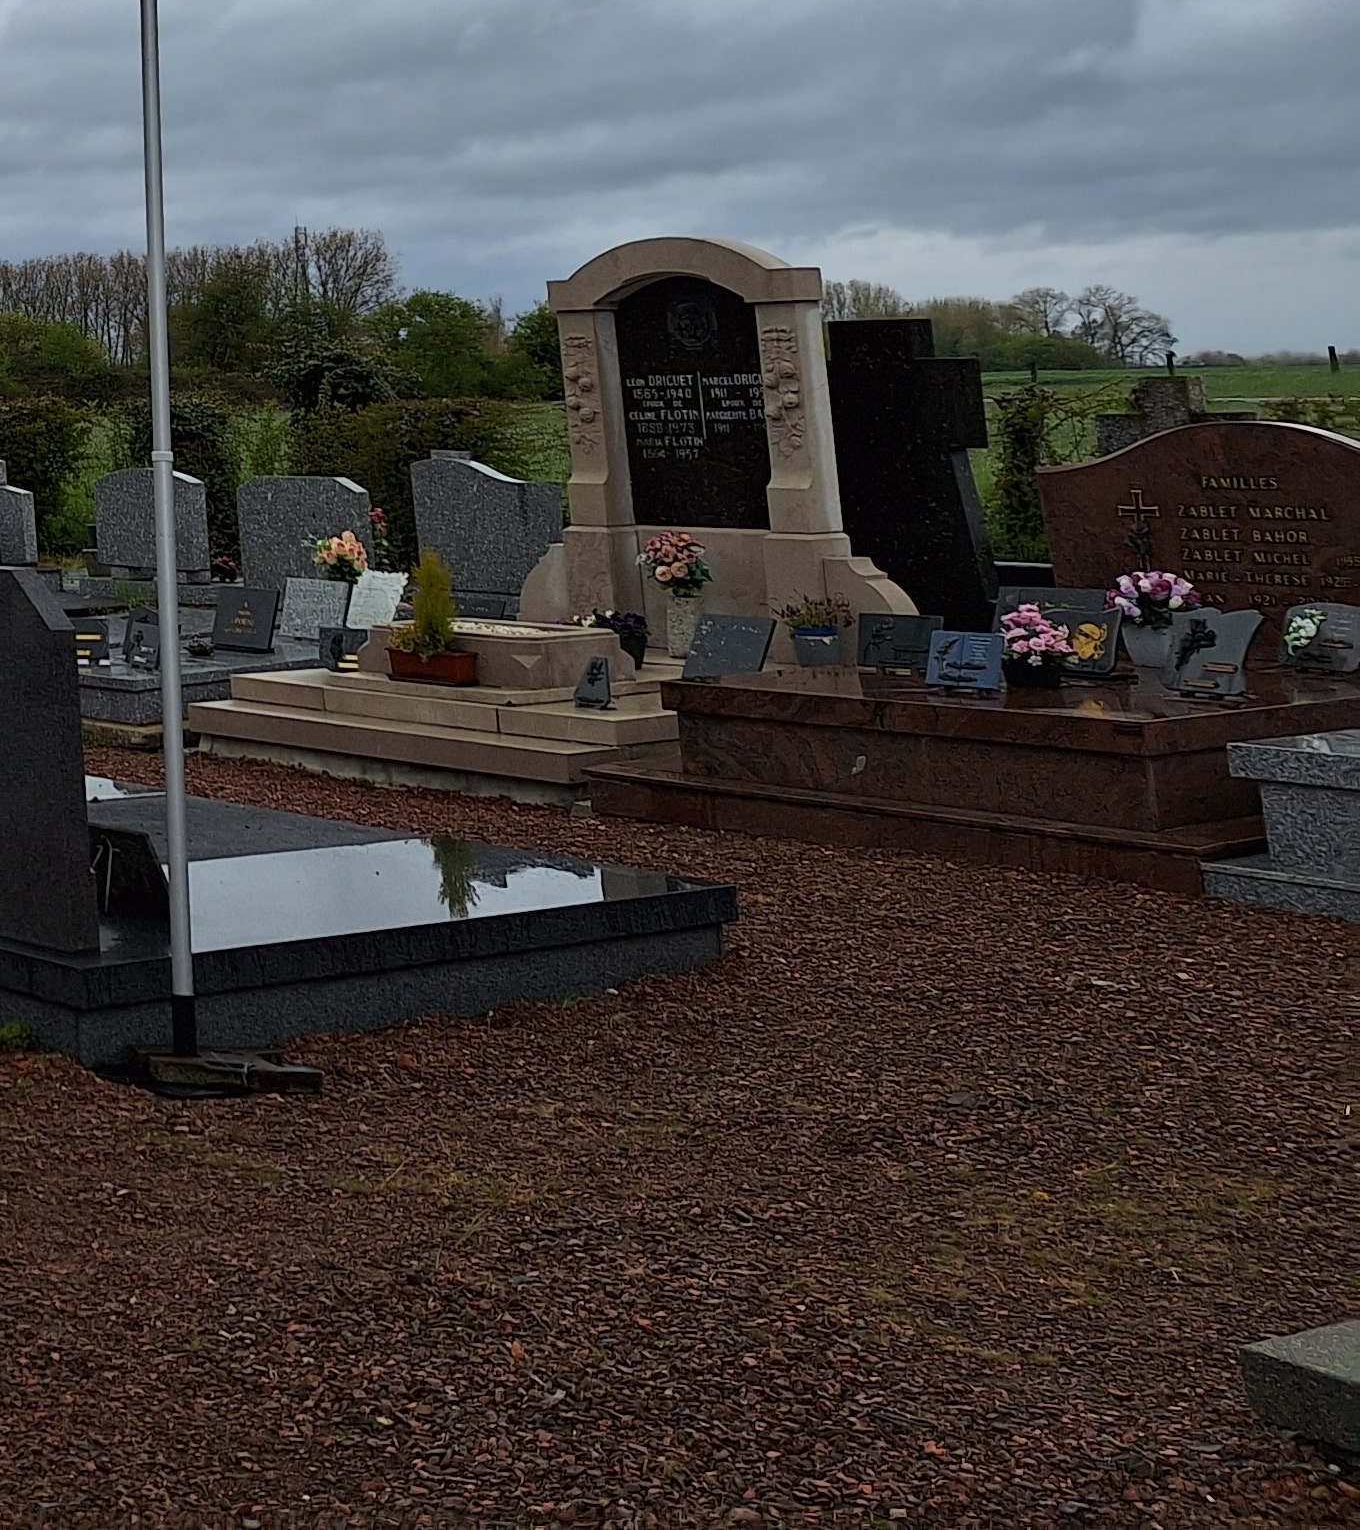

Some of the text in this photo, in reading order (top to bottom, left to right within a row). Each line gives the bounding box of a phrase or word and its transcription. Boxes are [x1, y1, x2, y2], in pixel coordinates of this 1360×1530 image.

[1201, 476, 1279, 490] FAMILLES
[1177, 504, 1331, 521] ZABLET MARCHAL
[1180, 527, 1241, 541] ZABLET
[1182, 547, 1243, 562] ZABLET
[1253, 551, 1311, 565] MICHEL
[1183, 569, 1229, 583] MARIE
